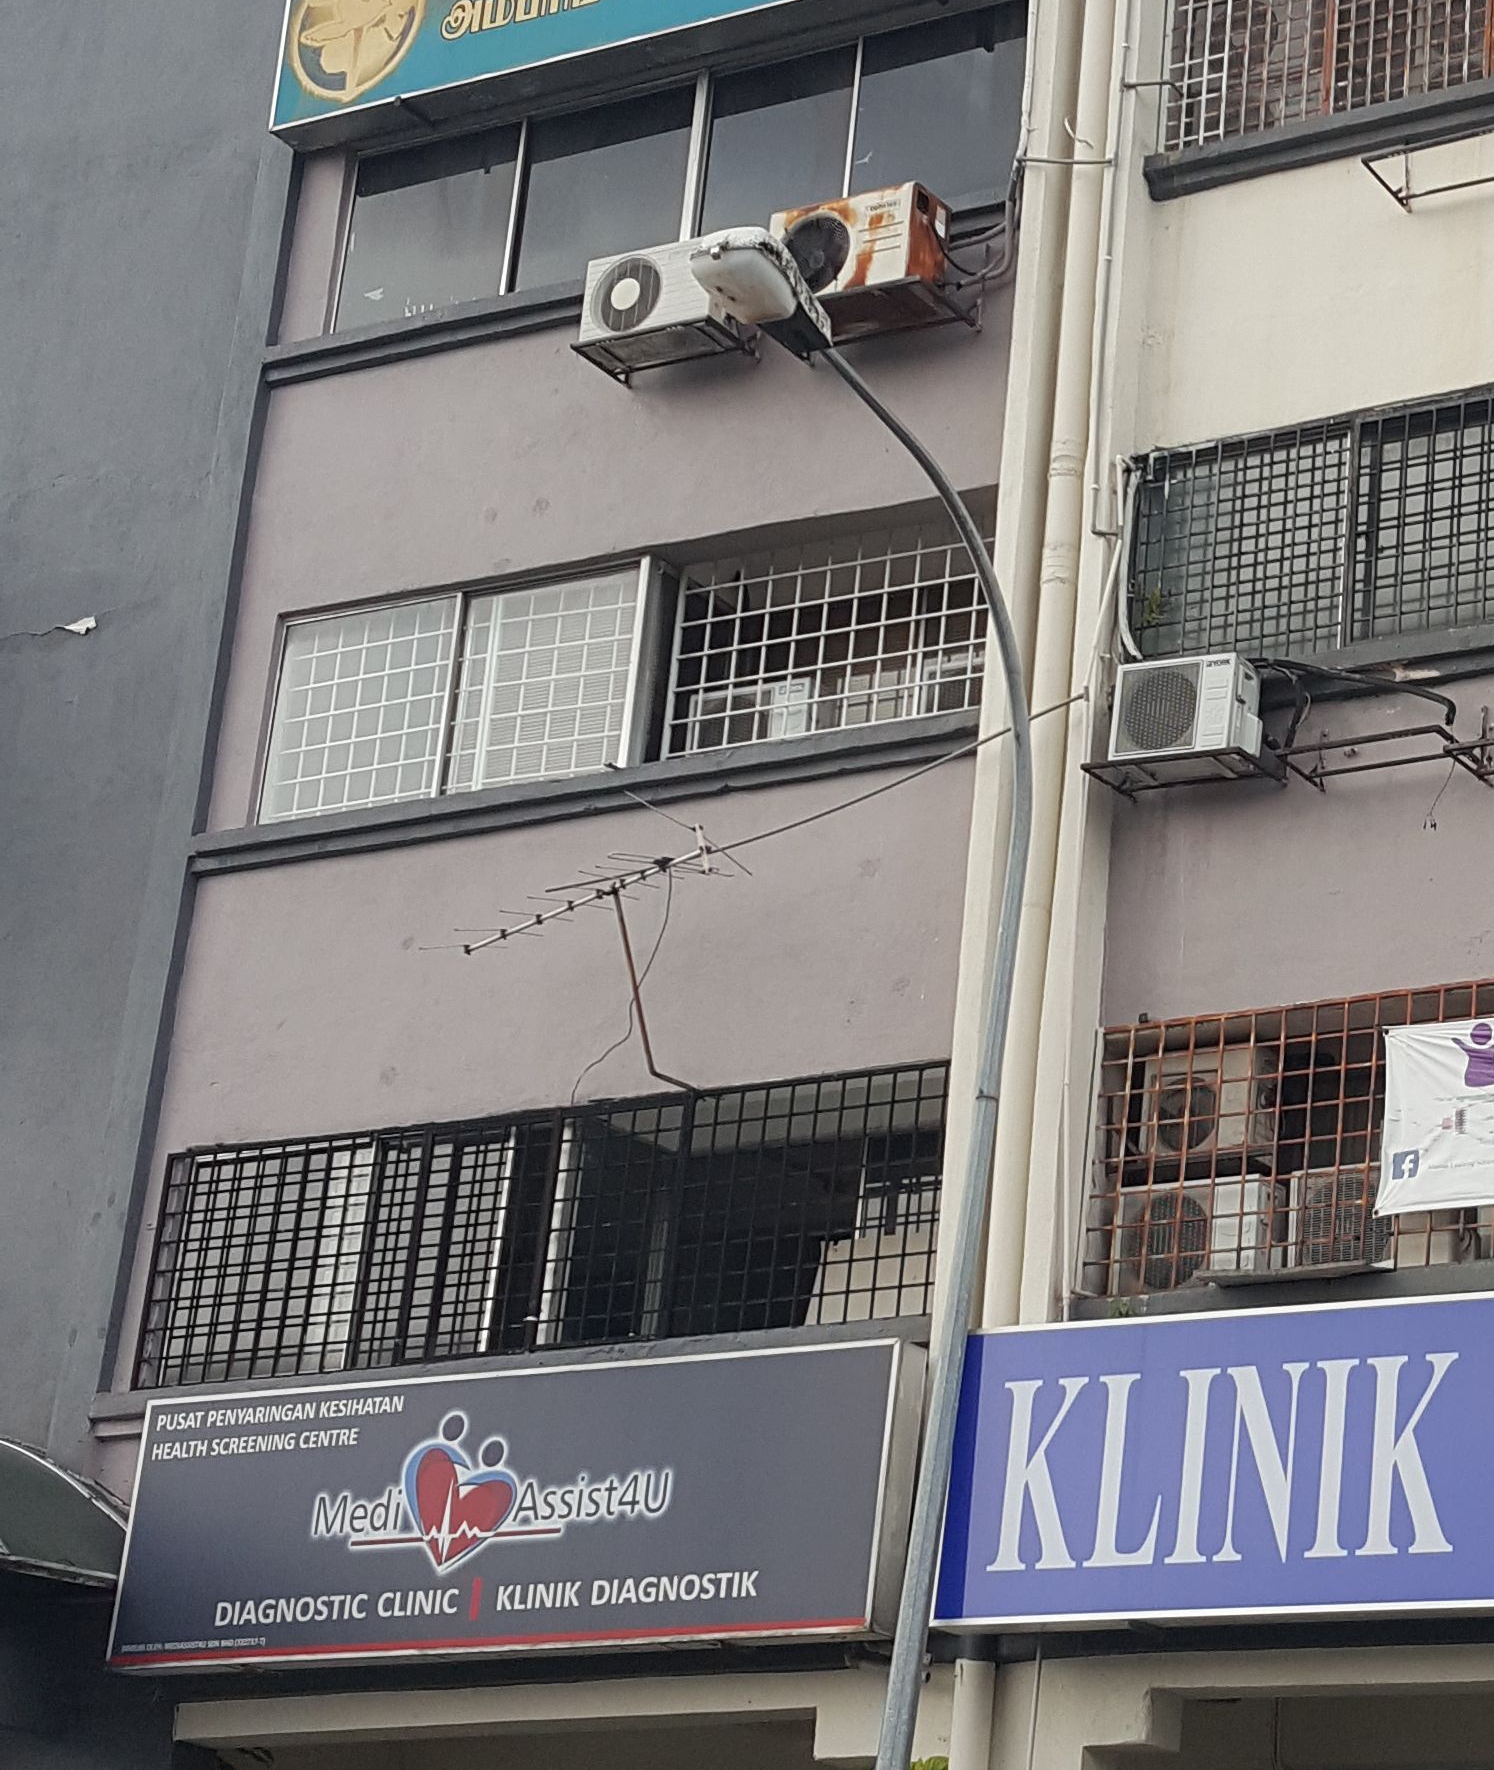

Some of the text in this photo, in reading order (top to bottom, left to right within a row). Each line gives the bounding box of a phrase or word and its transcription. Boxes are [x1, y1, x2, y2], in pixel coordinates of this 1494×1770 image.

[156, 1396, 404, 1431] PUSAT PENYARINGAN KESIHATAN
[151, 1428, 360, 1460] HEALTH SCREENING CENTRE
[986, 1351, 1458, 1573] KLINIK
[312, 1471, 671, 1537] Medi Assist4U
[214, 1570, 759, 1627] DIAGNOSTIC CLINIC KLINIK DIAGNOSTIK
